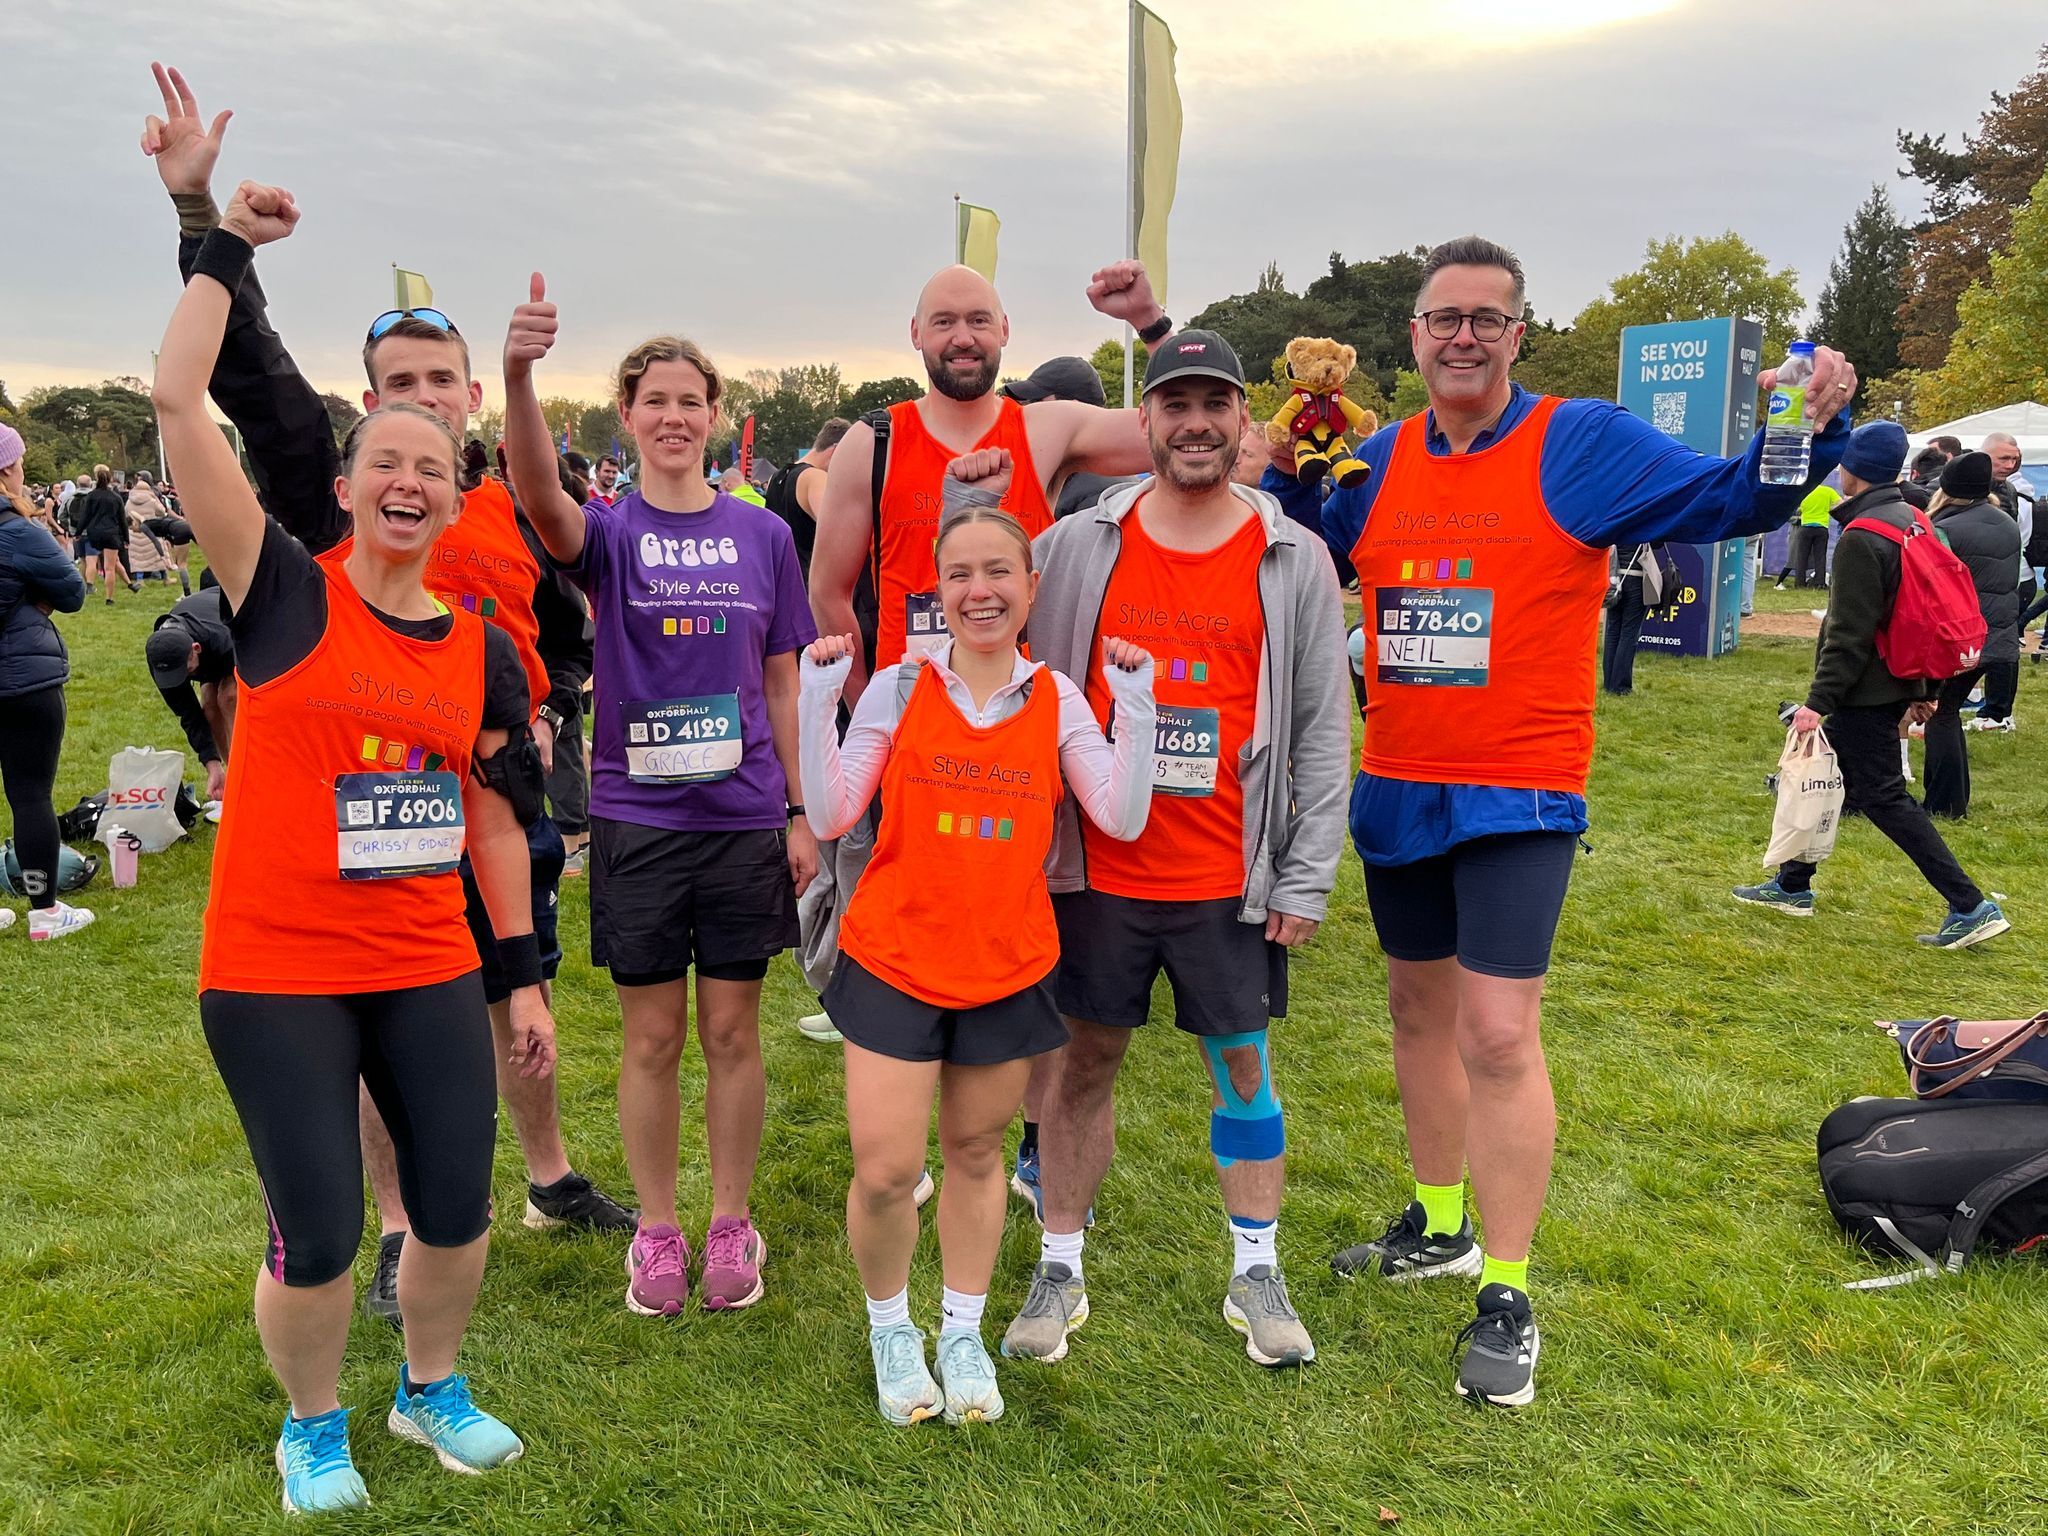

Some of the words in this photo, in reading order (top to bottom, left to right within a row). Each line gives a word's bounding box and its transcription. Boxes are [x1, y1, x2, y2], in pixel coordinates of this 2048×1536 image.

[1640, 343, 1667, 362] SEE
[1670, 340, 1708, 359] YOU
[1641, 365, 1658, 383] IN
[1661, 362, 1705, 381] 2025
[1393, 510, 1436, 534] Style
[1443, 511, 1500, 529] Acre
[640, 532, 739, 568] Grace
[1430, 536, 1447, 545] with
[1449, 535, 1483, 546] learning
[464, 548, 510, 573] Acre
[649, 579, 691, 597] Style
[696, 580, 740, 595] Acre
[662, 599, 687, 607] people
[688, 599, 702, 607] with
[703, 599, 730, 608] learning
[1118, 603, 1168, 629] Style
[1174, 610, 1229, 633] Acre
[1399, 610, 1412, 631] E
[1415, 610, 1483, 633] 7840
[1132, 634, 1161, 644] people
[1163, 636, 1179, 645] with
[1180, 638, 1213, 649] learning
[1387, 637, 1445, 664] NEIL
[1638, 635, 1664, 644] CTOBER
[348, 671, 415, 706] Style
[423, 692, 471, 728] Acre
[305, 697, 364, 716] Supporting
[365, 707, 403, 725] people
[406, 718, 427, 731] with
[427, 723, 458, 743] learning
[652, 722, 671, 742] D
[676, 717, 729, 740] 4129
[1155, 728, 1211, 753] 1682
[644, 747, 715, 773] GRACE
[932, 755, 981, 780] Style
[988, 764, 1031, 785] Acre
[905, 774, 943, 788] Supporting
[945, 782, 970, 791] people
[972, 784, 989, 794] with
[990, 787, 1018, 798] learning
[377, 800, 393, 824] F
[398, 798, 457, 824] 6906
[353, 839, 410, 855] CHRISSY
[418, 836, 457, 851] GIDNEY
[22, 868, 48, 896] S
